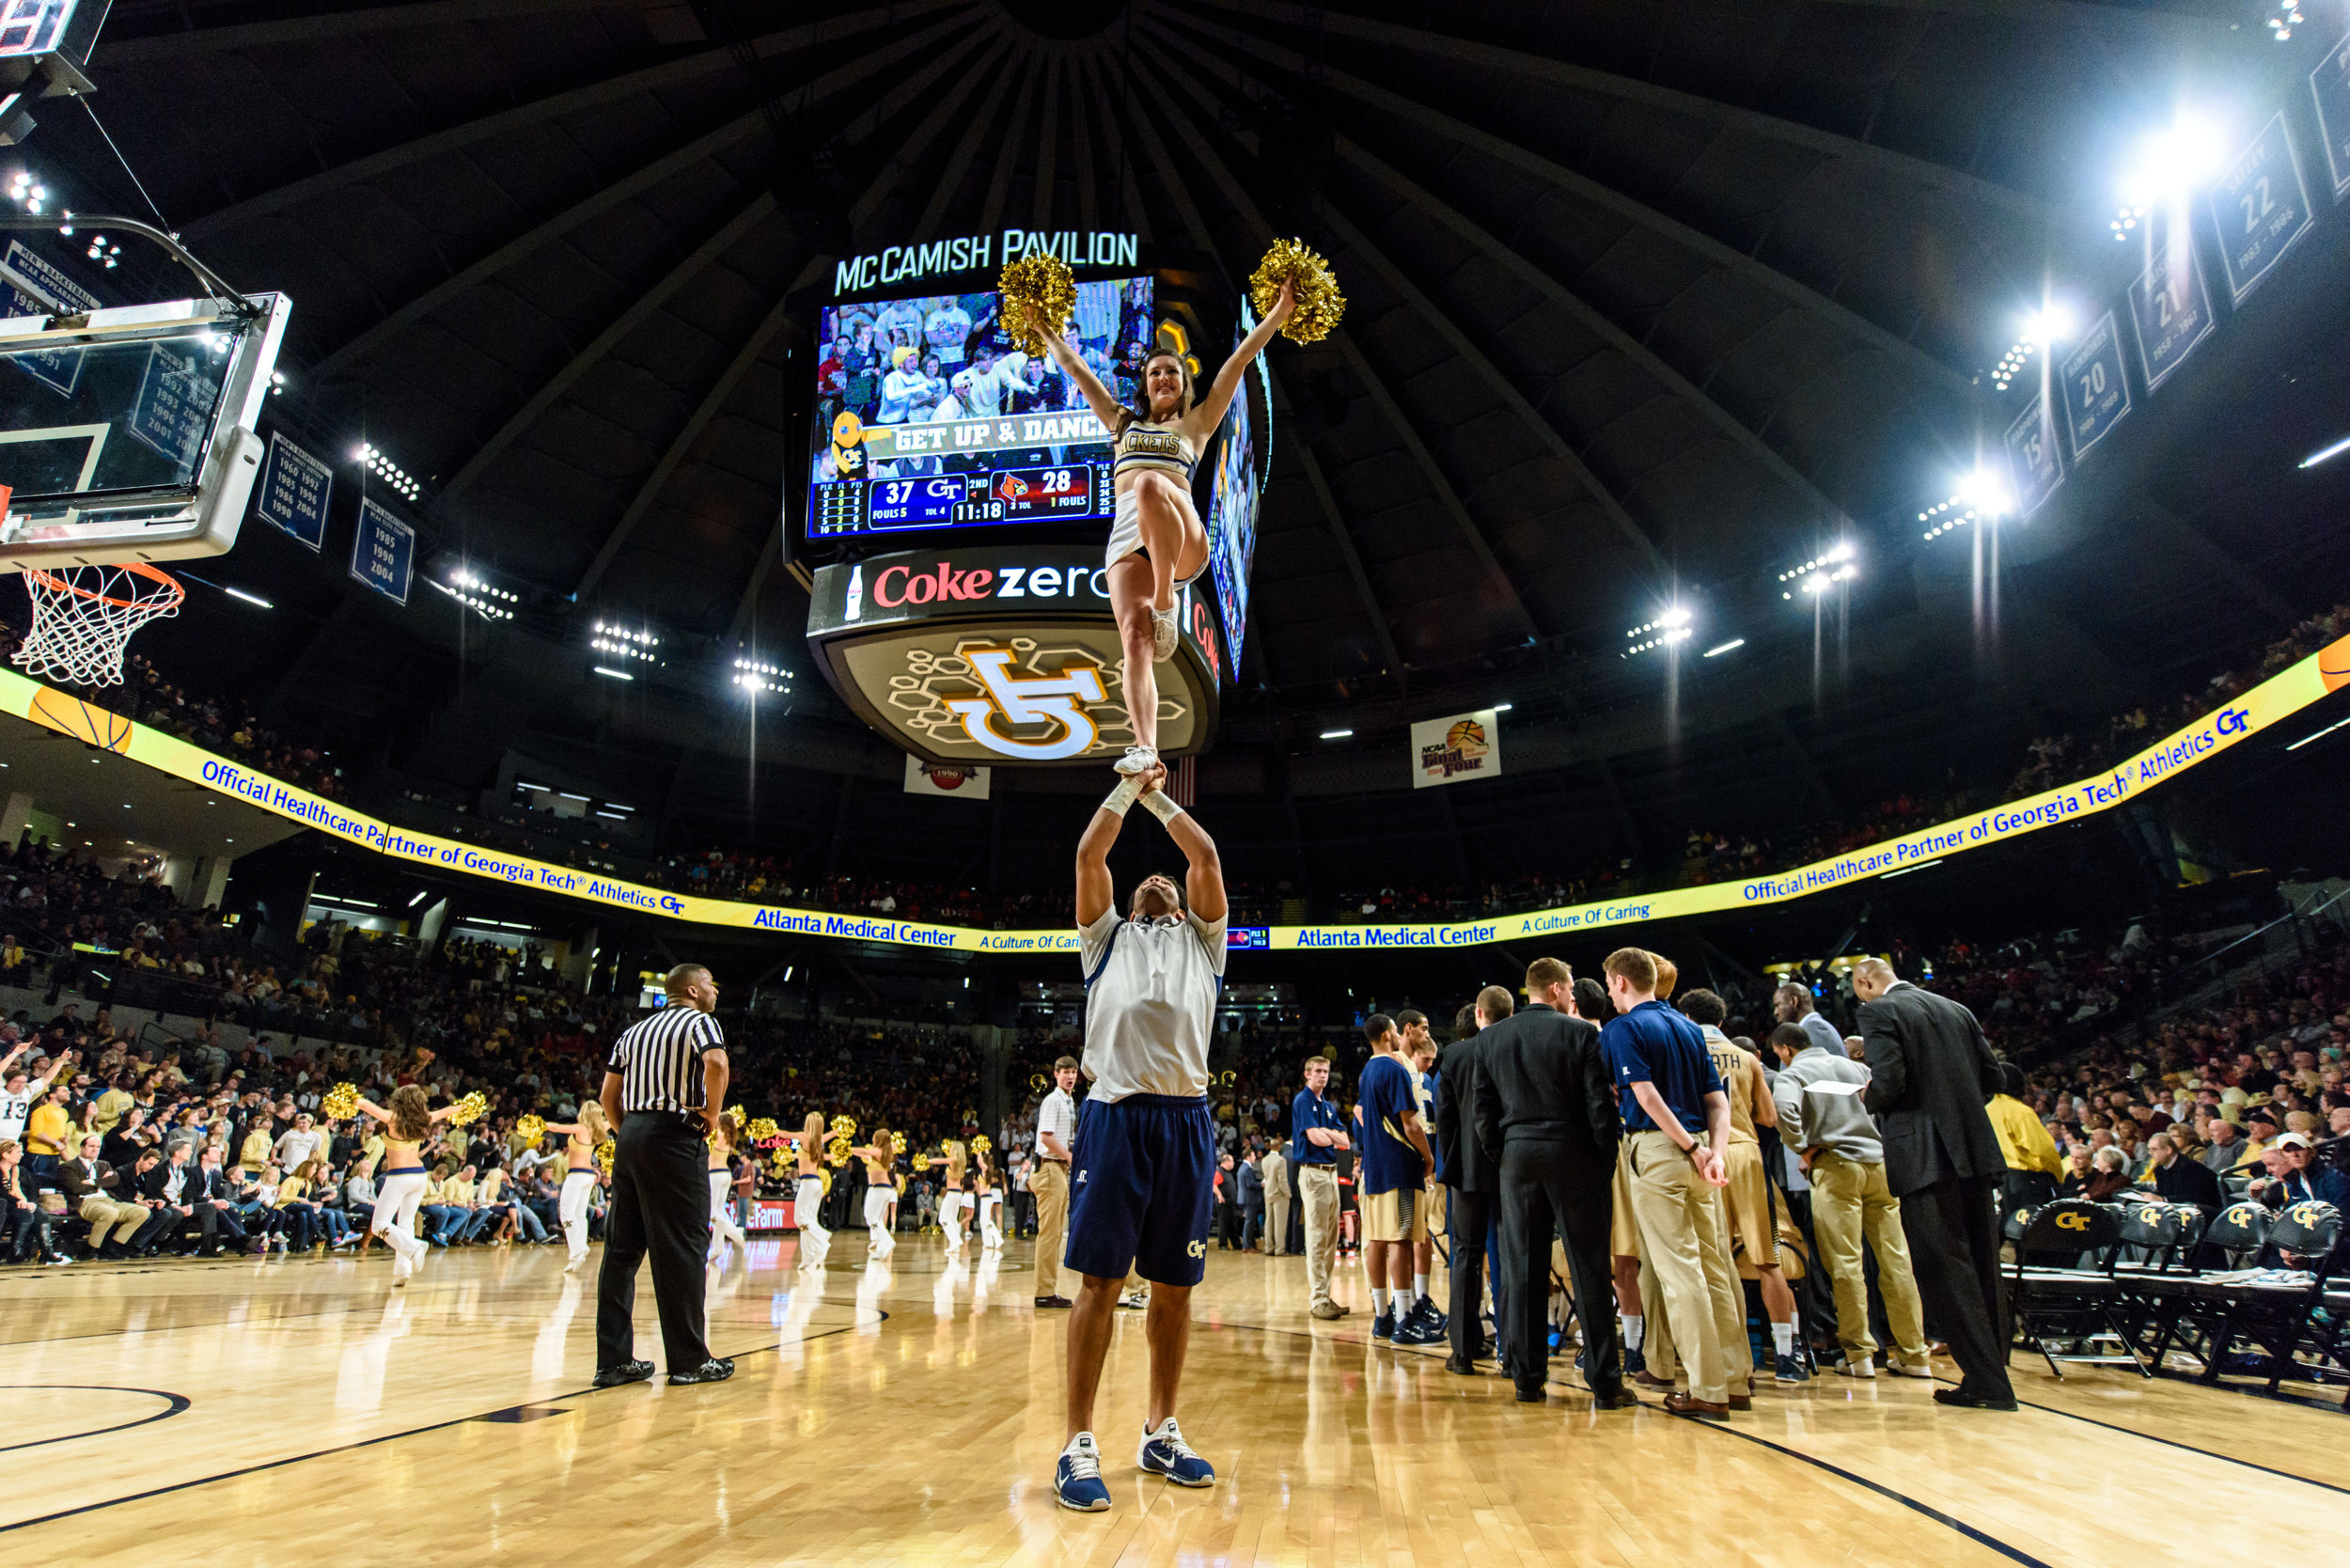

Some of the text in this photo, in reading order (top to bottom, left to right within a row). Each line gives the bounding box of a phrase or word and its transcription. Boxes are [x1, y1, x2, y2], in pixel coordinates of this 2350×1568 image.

[2240, 176, 2275, 233] 22
[1002, 229, 1137, 266] PAVILION
[47, 265, 92, 305] BASKETBALL
[162, 374, 182, 395] 1992
[2080, 361, 2106, 408] 20
[157, 387, 179, 410] 1993
[152, 402, 176, 425] 1996
[149, 417, 172, 440] 2001
[895, 428, 947, 451] GET
[955, 424, 990, 447] UP
[998, 424, 1015, 443] &
[1120, 433, 1180, 456] ACKETS
[280, 457, 320, 491] 1960 1992
[969, 478, 989, 489] 2ND
[1042, 470, 1072, 494] 28
[278, 471, 318, 506] 1985 1996
[838, 489, 844, 497] 3
[885, 478, 962, 504] 37 GT
[273, 499, 291, 519] 1990
[275, 485, 316, 519] 1986 2004
[822, 509, 829, 517] 4
[872, 508, 907, 519] FOULS 5
[957, 502, 1002, 521] 11:18
[1051, 496, 1087, 508] 1 FOULS
[376, 526, 395, 549] 1985
[373, 543, 395, 565] 1990
[370, 560, 393, 583] 2004
[872, 562, 993, 608] Coke
[1421, 747, 1463, 769] Final
[1422, 743, 1446, 754] NCAA
[936, 769, 959, 777] 1990
[1443, 757, 1482, 778] Four
[1744, 874, 1805, 901] Official
[1807, 852, 1893, 888] Healthcare
[1897, 827, 1965, 861] Partner
[1969, 817, 1989, 840] of
[1993, 793, 2080, 833] Georgia
[2139, 729, 2215, 784] Athletics
[202, 760, 271, 804] Official
[273, 786, 364, 839] Healthcare
[366, 825, 437, 859] Partner
[441, 846, 462, 865] of
[464, 852, 534, 882] Georgia
[588, 880, 656, 910] Athletics
[754, 908, 957, 948] Atlanta Medical Center
[1521, 919, 1531, 933] A
[1534, 914, 1581, 933] Culture
[1585, 908, 1602, 923] Of
[979, 934, 1080, 949] A Culture Of Cari
[1297, 924, 1496, 948] Atlanta Medical Center
[1711, 1054, 1741, 1069] ATH
[3, 1101, 27, 1121] 13
[754, 1203, 783, 1228] Farm
[2055, 1212, 2091, 1231] GT
[2139, 1207, 2162, 1228] GT
[2228, 1207, 2252, 1228] GT
[2293, 1207, 2319, 1230] GT
[1187, 1239, 1205, 1260] GT
